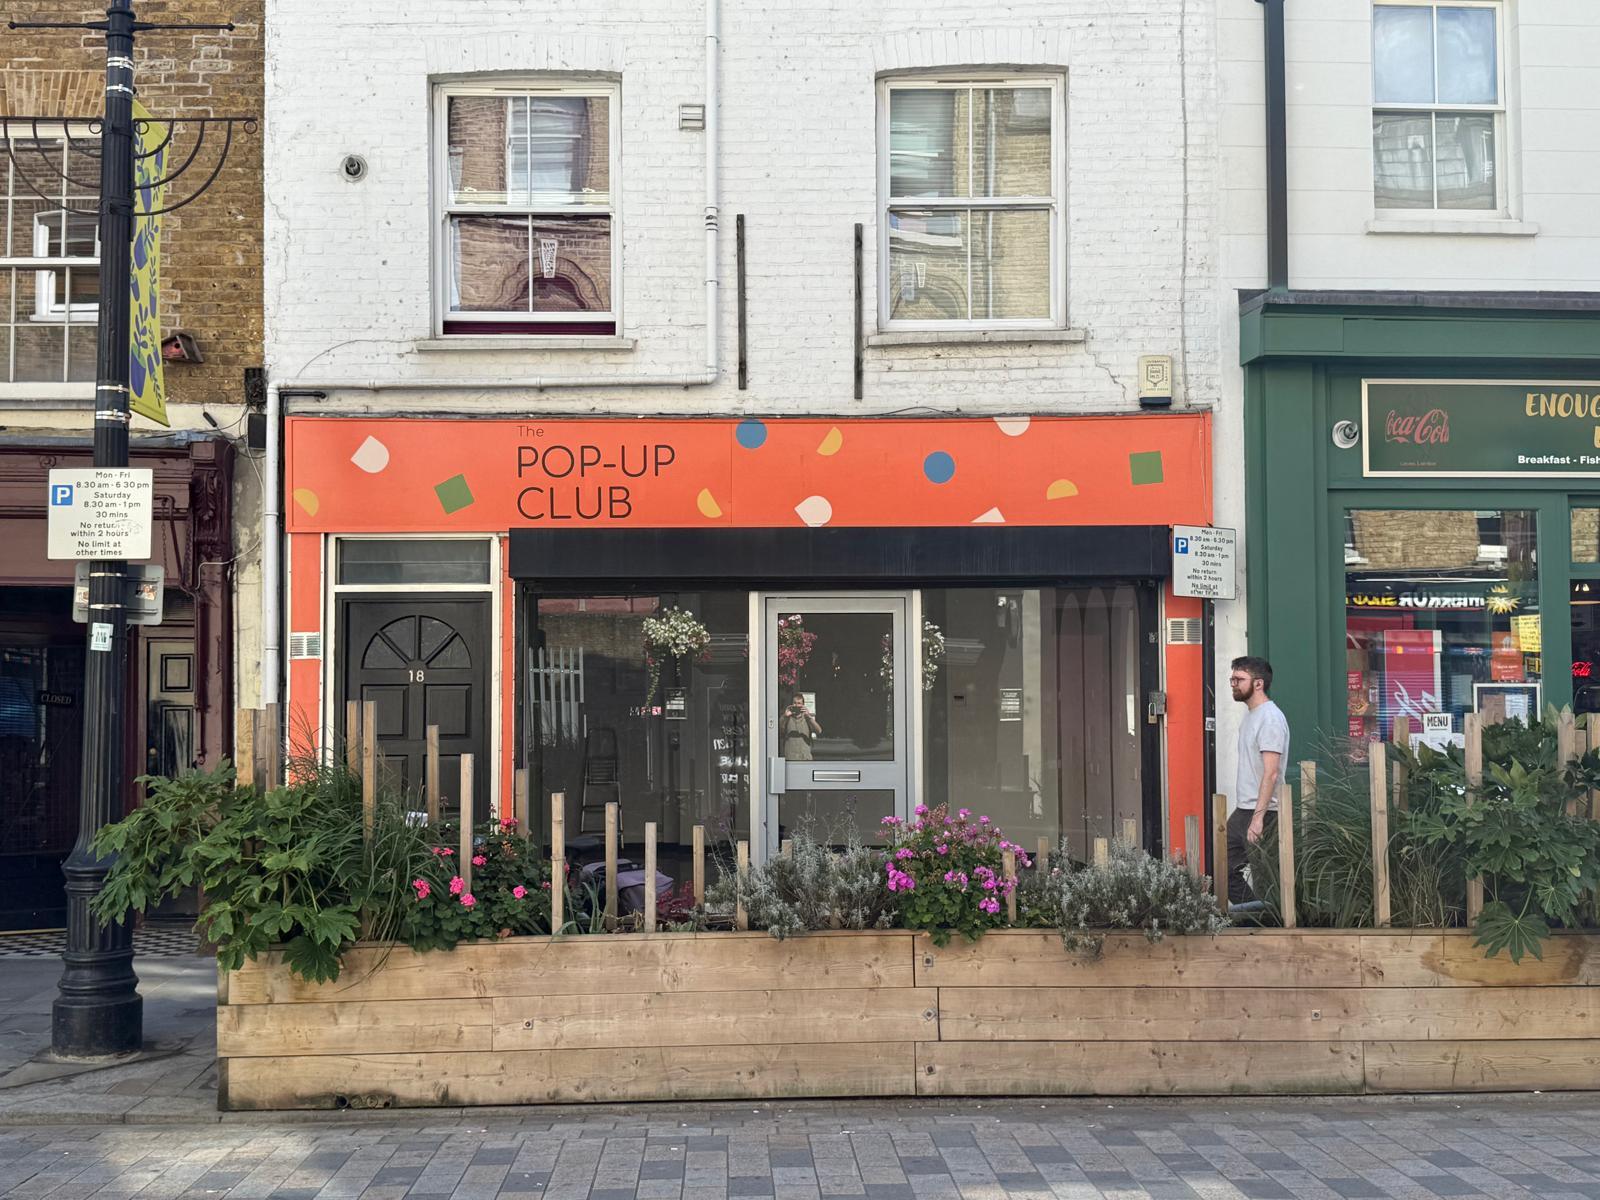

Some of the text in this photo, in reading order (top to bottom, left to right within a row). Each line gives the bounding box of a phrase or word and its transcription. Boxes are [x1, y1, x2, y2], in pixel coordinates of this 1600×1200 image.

[518, 425, 544, 437] The
[518, 445, 675, 478] POP-UP
[1518, 455, 1571, 464] Breakfast
[95, 471, 113, 479] Mon
[119, 471, 131, 479] Fri
[76, 481, 96, 489] 8.30
[136, 482, 150, 490] pm
[56, 487, 71, 504] P
[93, 491, 132, 500] Saturday
[83, 500, 104, 509] 8.30
[517, 486, 632, 519] CLUB
[79, 521, 92, 529] No
[97, 529, 104, 537] 2
[77, 540, 122, 548] No limit at
[1178, 539, 1187, 552] P
[1200, 544, 1223, 552] Saturday
[408, 670, 425, 683] 18
[1426, 716, 1449, 728] MENU
